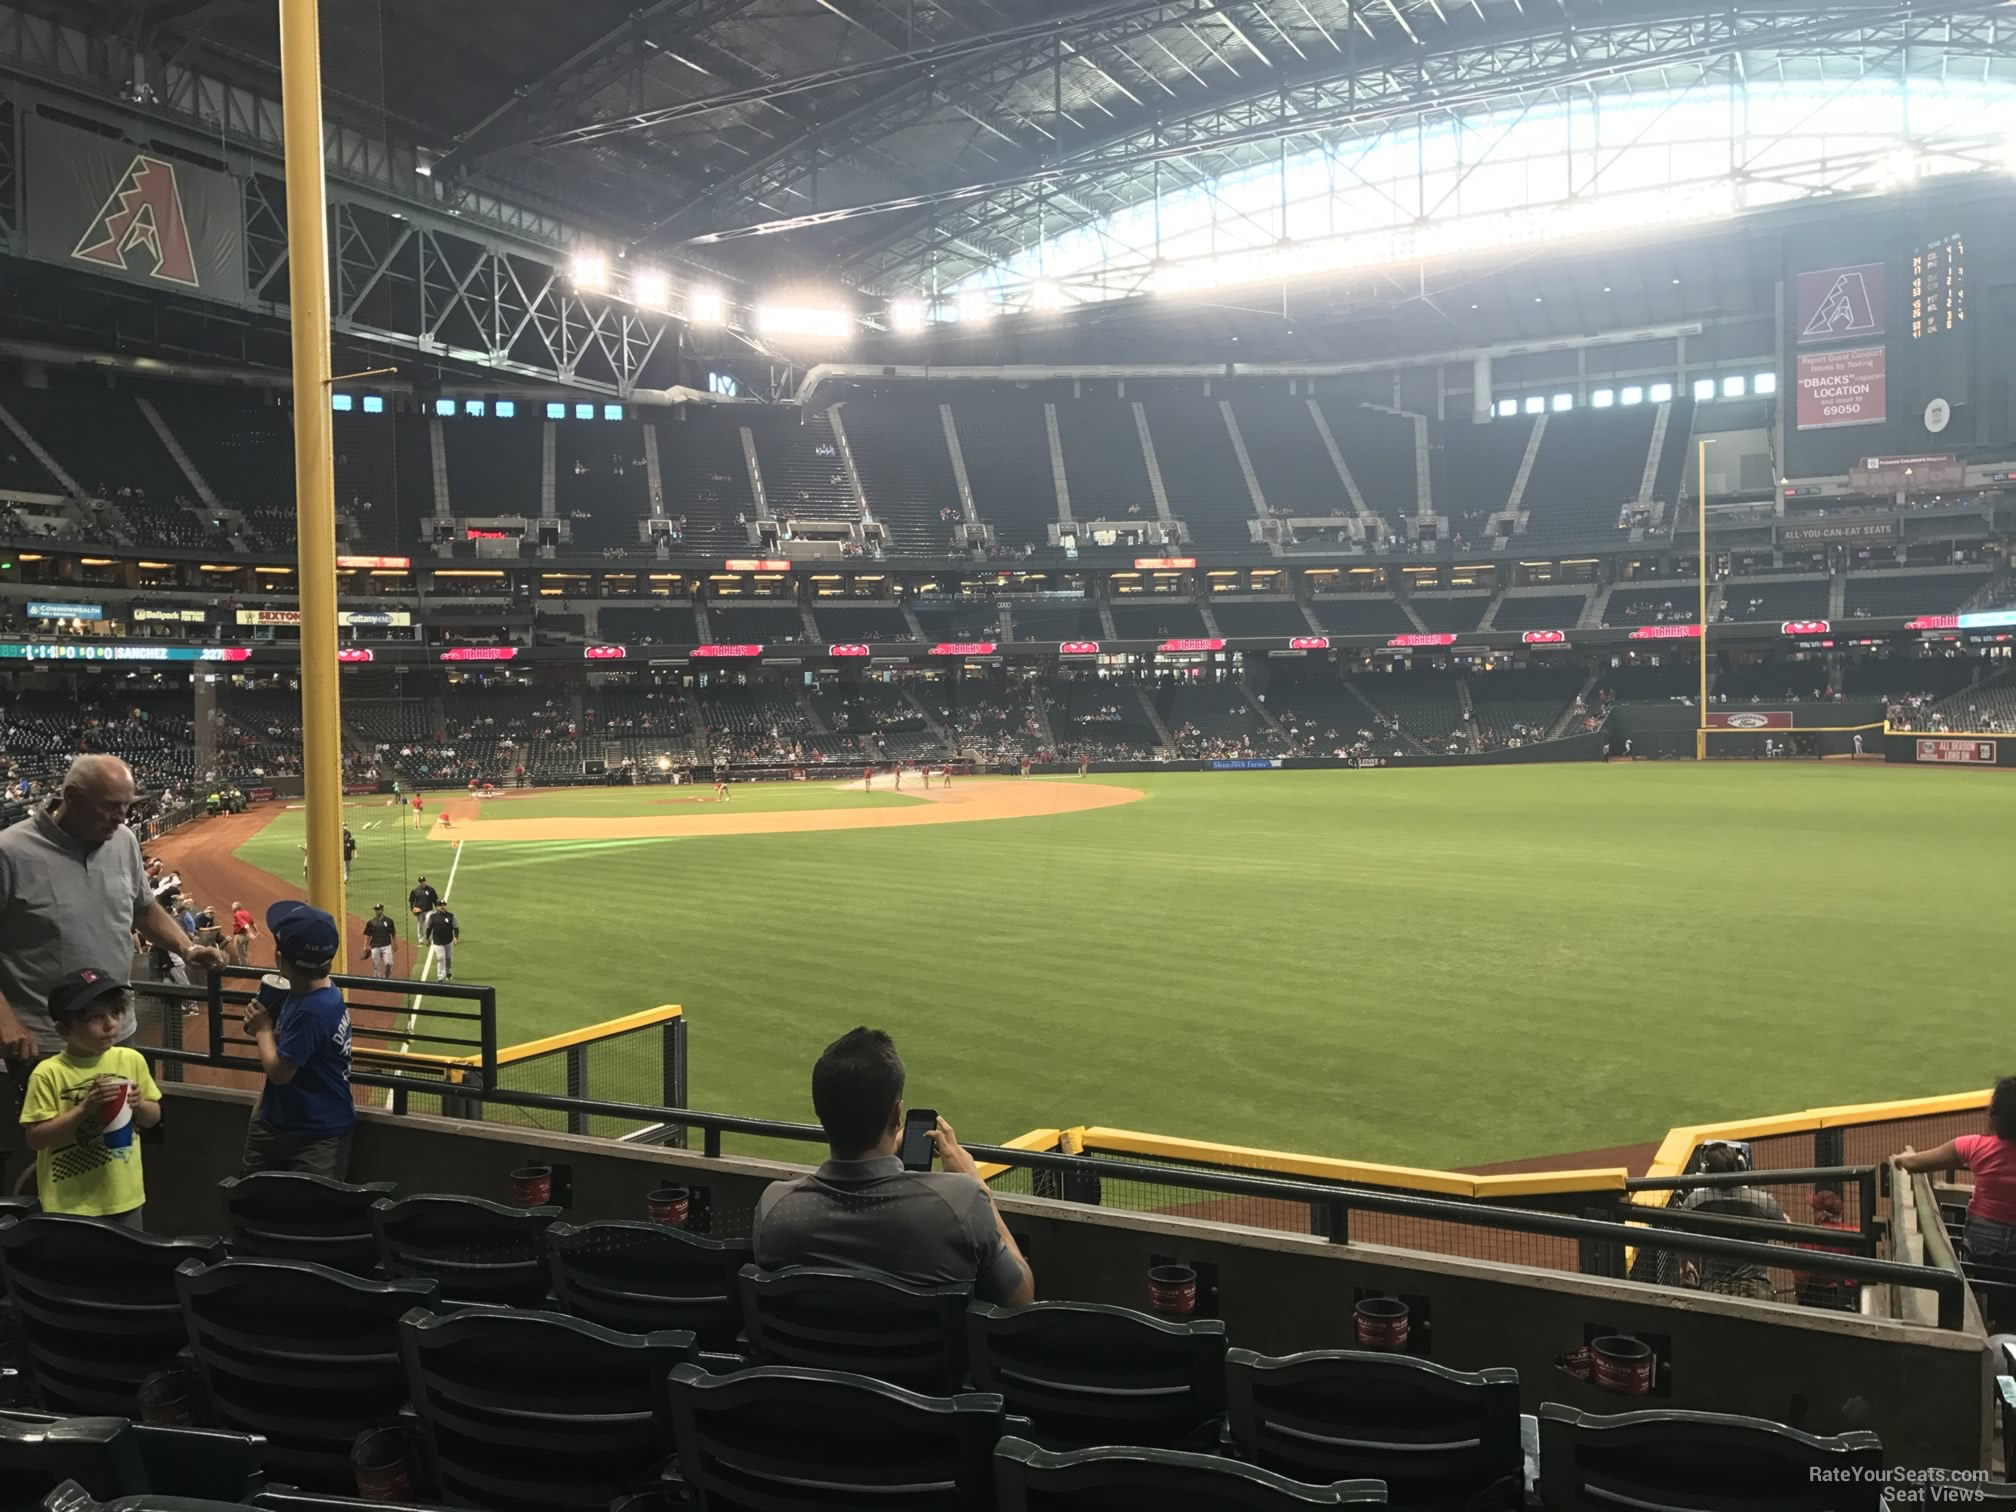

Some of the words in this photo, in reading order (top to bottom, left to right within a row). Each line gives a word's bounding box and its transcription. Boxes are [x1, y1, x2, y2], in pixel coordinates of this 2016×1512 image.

[1828, 354, 1849, 362] Guest
[1851, 350, 1882, 359] Conduct
[1814, 384, 1870, 398] LOCATION
[1823, 403, 1860, 416] 69050
[1863, 524, 1892, 535] SEATS
[146, 610, 180, 621] Ballpark
[117, 646, 168, 660] SANCHEZ
[1939, 741, 1950, 751] ALL
[1951, 741, 1976, 751] SEASON
[1945, 751, 1960, 761] LONG
[1961, 751, 1970, 761] ON
[1247, 760, 1268, 768] Farms
